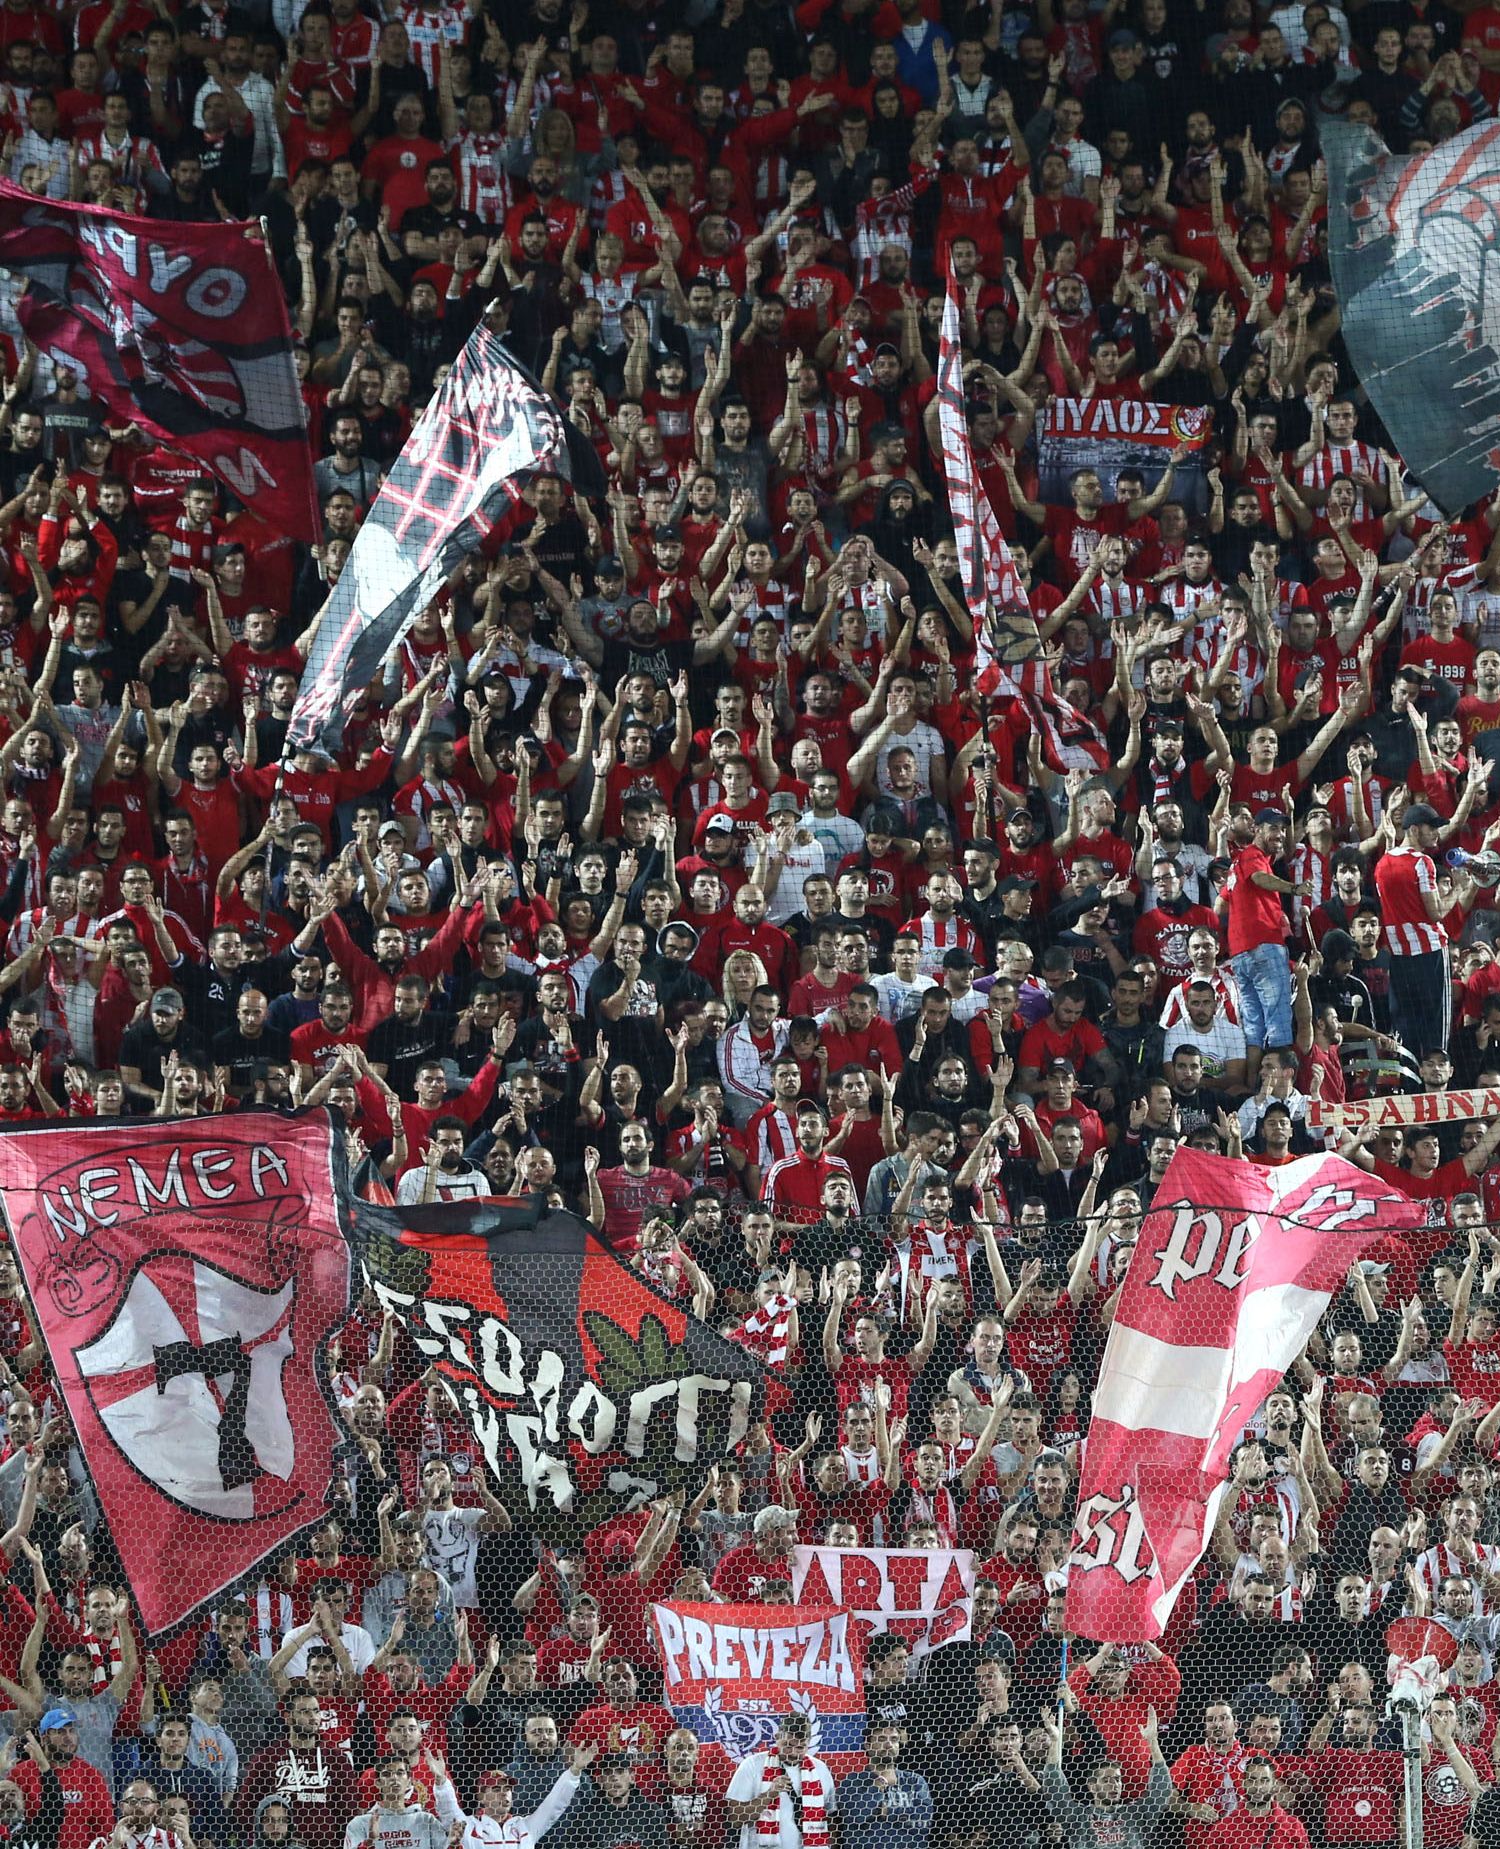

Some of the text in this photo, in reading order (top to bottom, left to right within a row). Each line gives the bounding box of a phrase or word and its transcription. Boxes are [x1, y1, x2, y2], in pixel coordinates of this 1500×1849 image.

[1439, 665, 1465, 679] 1998
[41, 1144, 289, 1242] NEMEA
[153, 1331, 252, 1491] 7
[1401, 1458, 1411, 1472] 8
[794, 1553, 972, 1612] ARTA
[655, 1611, 857, 1693] PREVEZA
[737, 1699, 774, 1712] EST.
